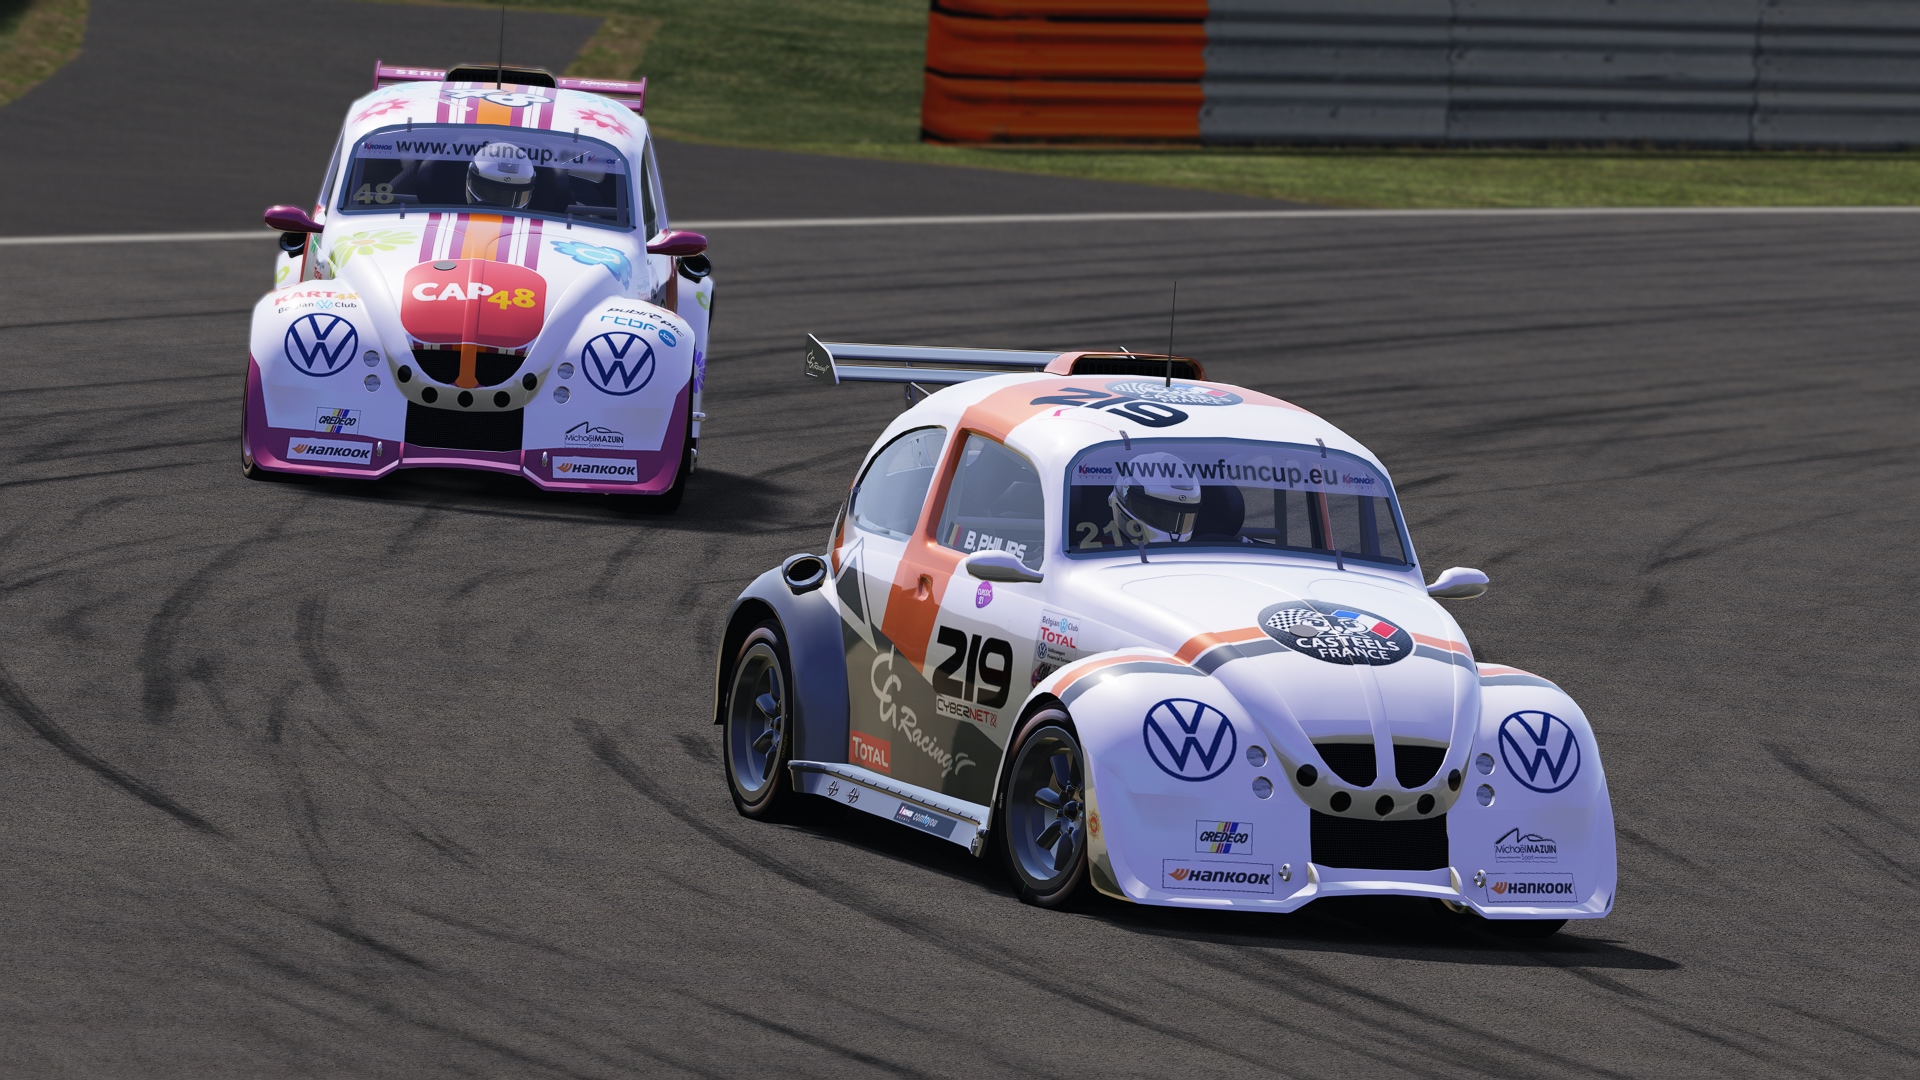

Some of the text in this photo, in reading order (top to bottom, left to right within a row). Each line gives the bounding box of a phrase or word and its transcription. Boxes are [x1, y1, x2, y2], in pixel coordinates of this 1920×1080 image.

[364, 141, 393, 150] KRONOS
[353, 182, 395, 204] 48
[334, 301, 358, 309] Club
[1030, 386, 1189, 428] 219
[318, 415, 357, 426] CREDECO
[1078, 463, 1113, 475] KRONOS
[1115, 458, 1338, 489] www.vwfuncup.eu
[1342, 472, 1376, 485] KRONOS
[963, 530, 977, 552] B.
[1075, 519, 1151, 549] 219
[1042, 615, 1060, 628] Belgian
[1067, 622, 1079, 633] Club
[1041, 626, 1077, 649] TOTAL
[1295, 636, 1401, 652] CASTEELS
[1318, 647, 1391, 661] FRANCE
[932, 624, 1014, 710] 219
[852, 735, 889, 768] TOTAL
[897, 705, 953, 779] Racing
[1199, 831, 1249, 844] CREDECO
